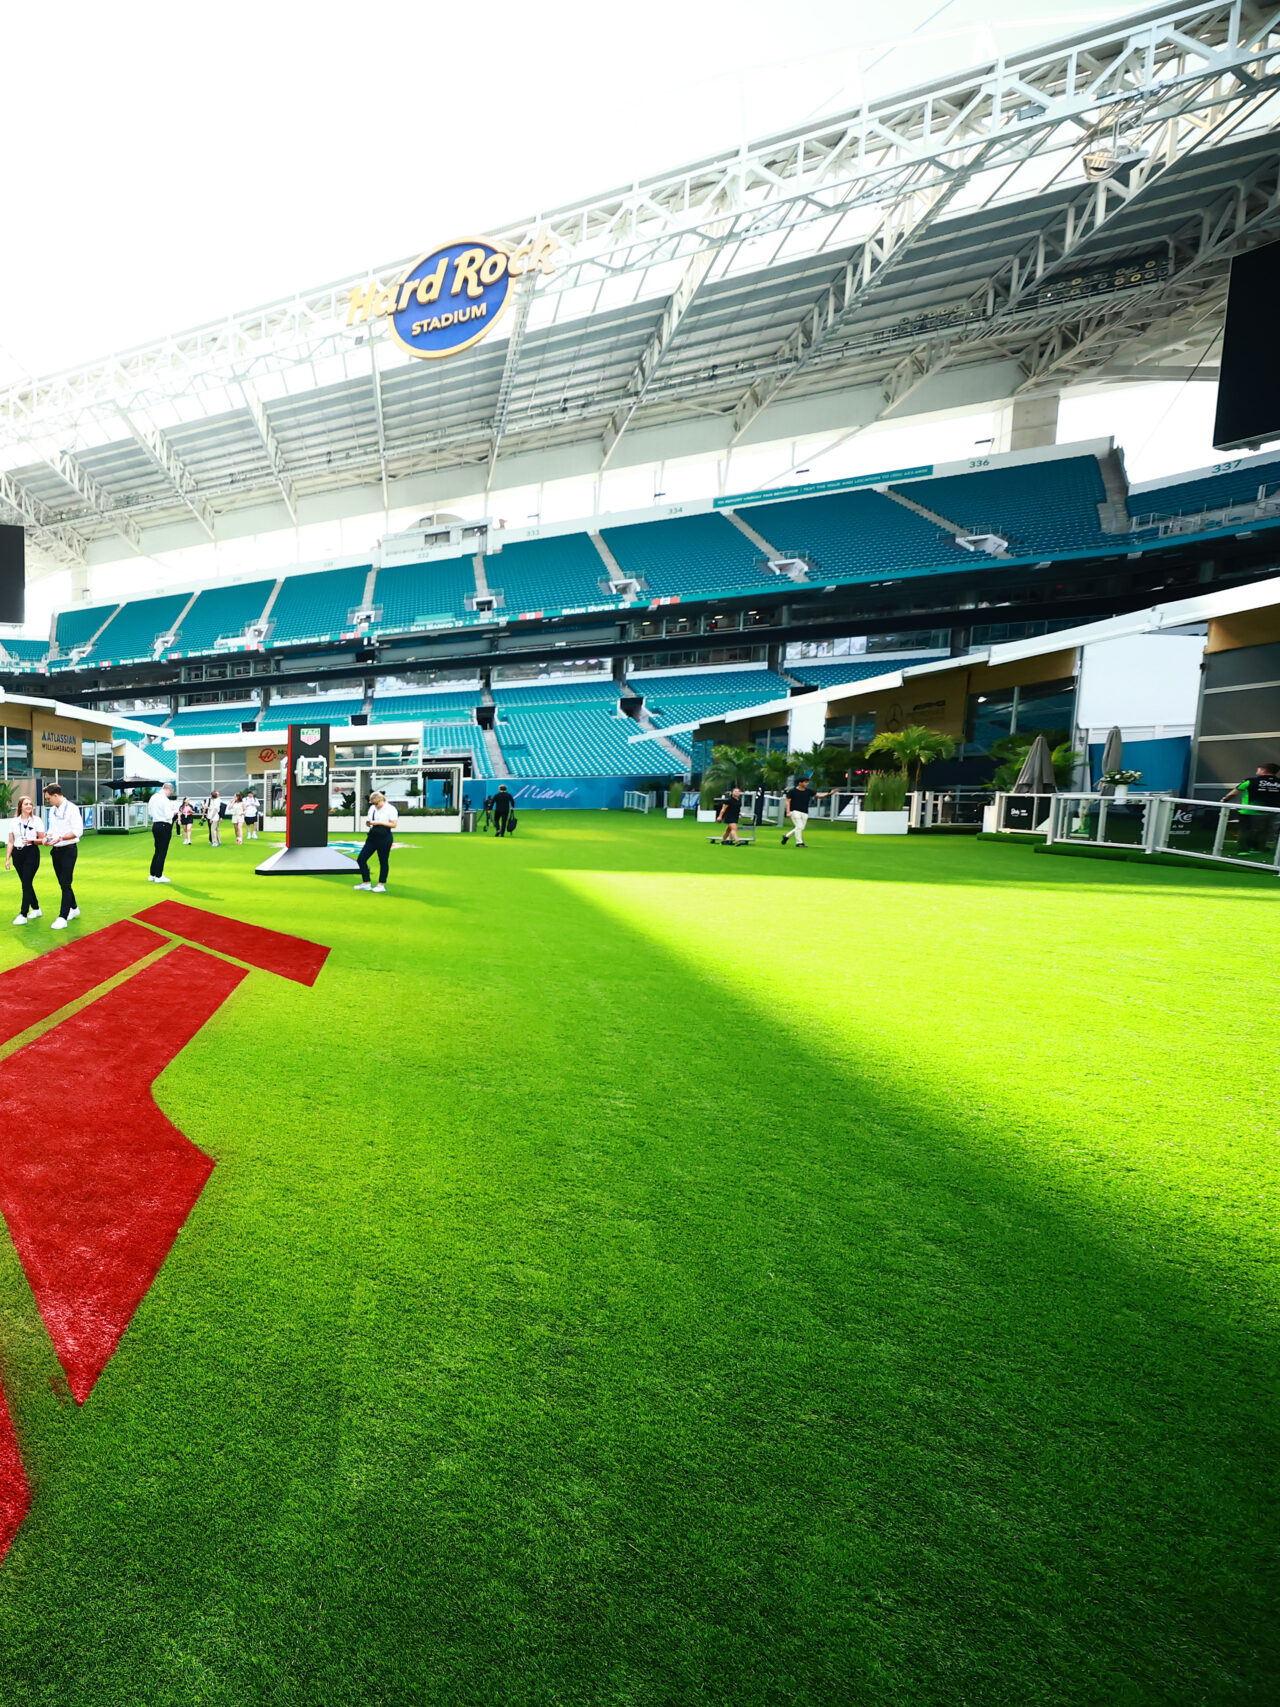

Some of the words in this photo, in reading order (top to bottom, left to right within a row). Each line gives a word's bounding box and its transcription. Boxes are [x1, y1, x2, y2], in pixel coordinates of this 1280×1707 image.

[346, 257, 449, 326] Hard
[451, 226, 559, 299] Rock
[411, 302, 488, 337] STADIUM
[969, 460, 990, 468] 336
[1211, 459, 1242, 473] 337
[47, 732, 77, 745] ATLASSIAN
